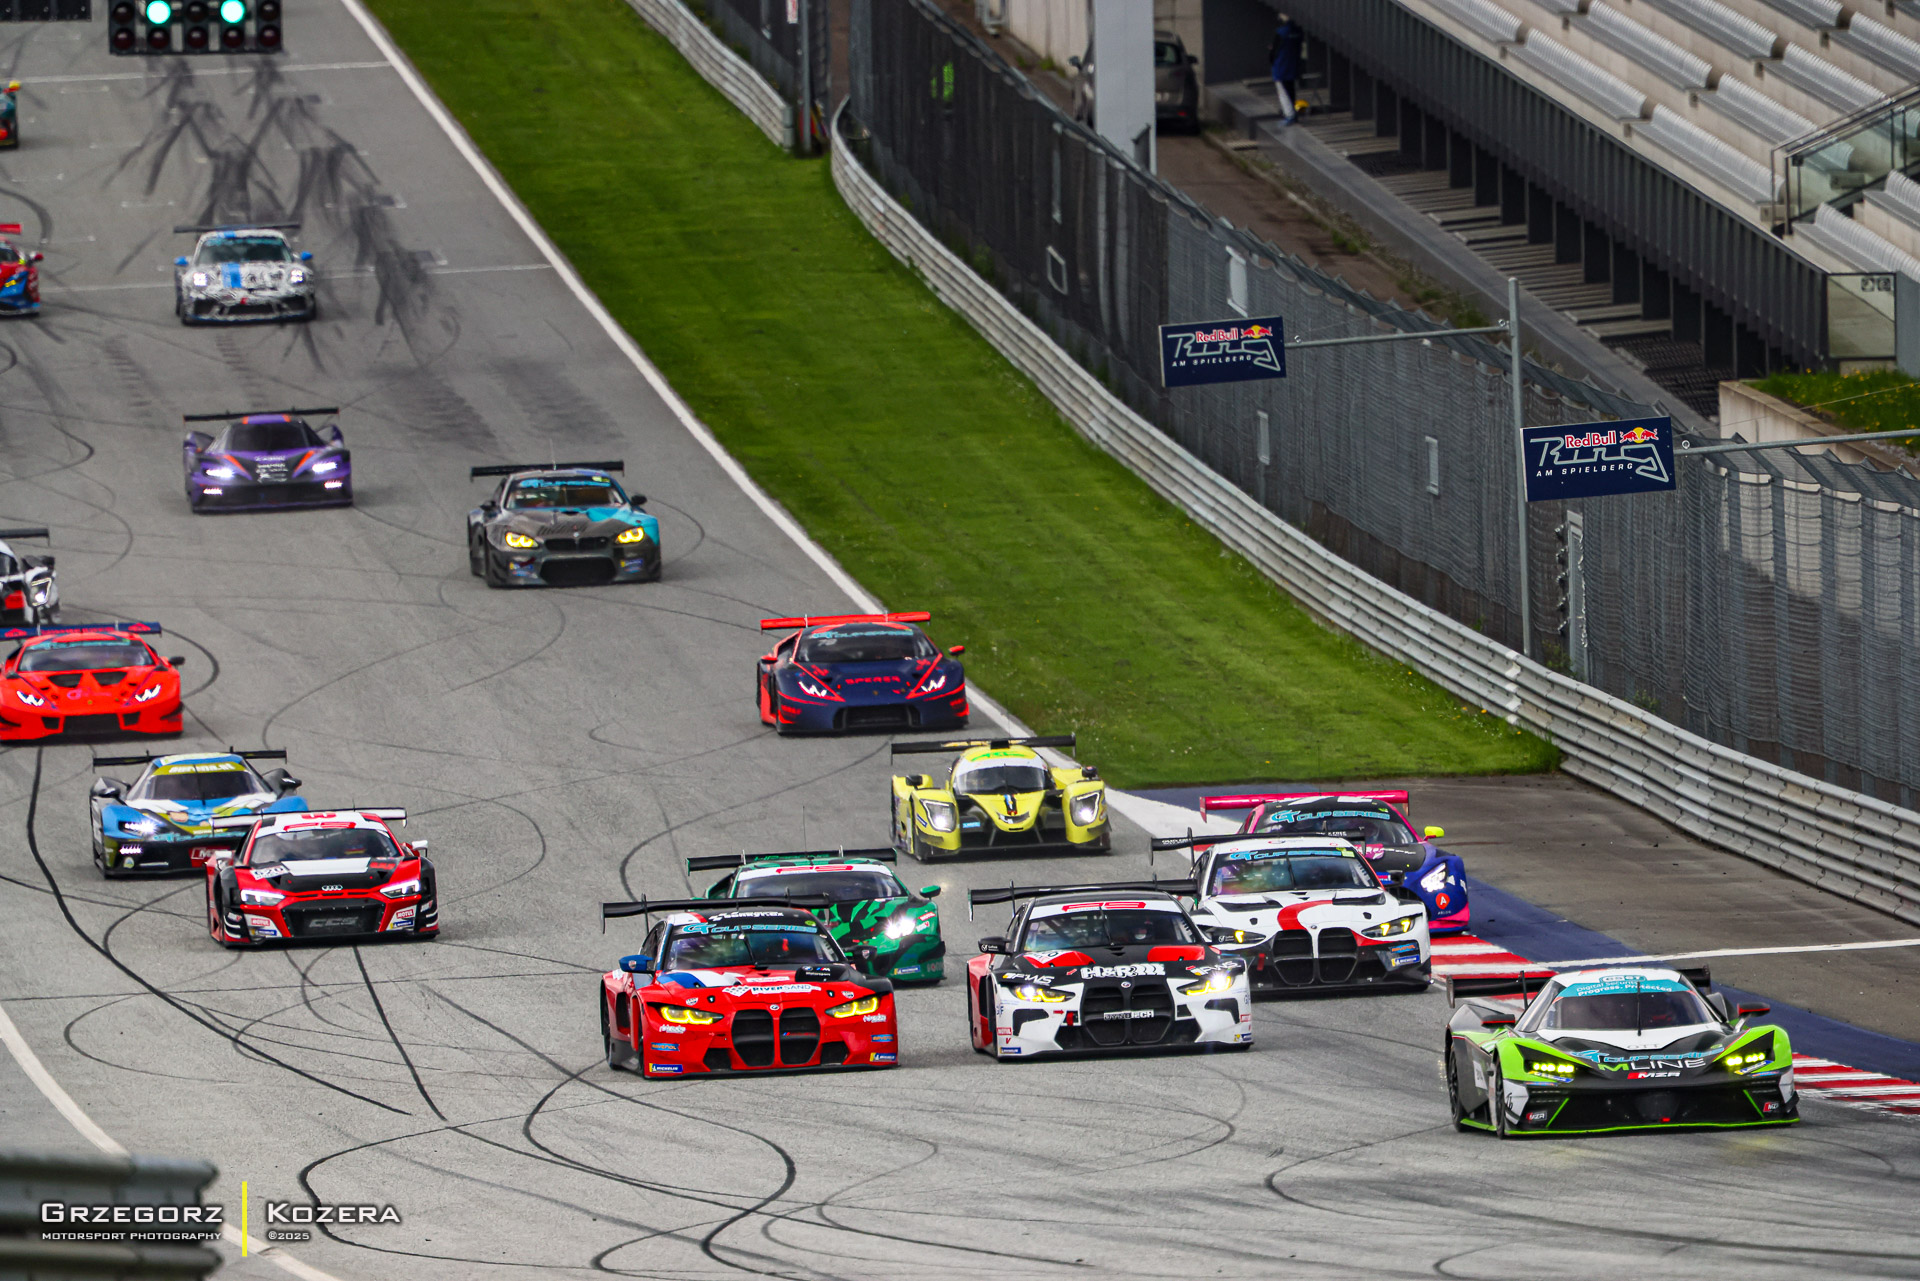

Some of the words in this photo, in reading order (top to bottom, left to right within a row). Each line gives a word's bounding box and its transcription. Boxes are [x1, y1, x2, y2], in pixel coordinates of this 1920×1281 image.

[1195, 329, 1217, 343] Red
[1217, 327, 1239, 341] Bull
[1193, 354, 1252, 366] SPIELBERG
[1565, 432, 1591, 448] Red
[1591, 430, 1616, 446] Bull
[1536, 469, 1553, 477] AM
[1562, 462, 1633, 475] SPIELBERG
[1298, 812, 1332, 821] CUP
[1332, 810, 1391, 820] SERIES
[751, 924, 818, 933] SERIES
[1576, 983, 1604, 991] Digital
[1578, 985, 1622, 996] Progress.
